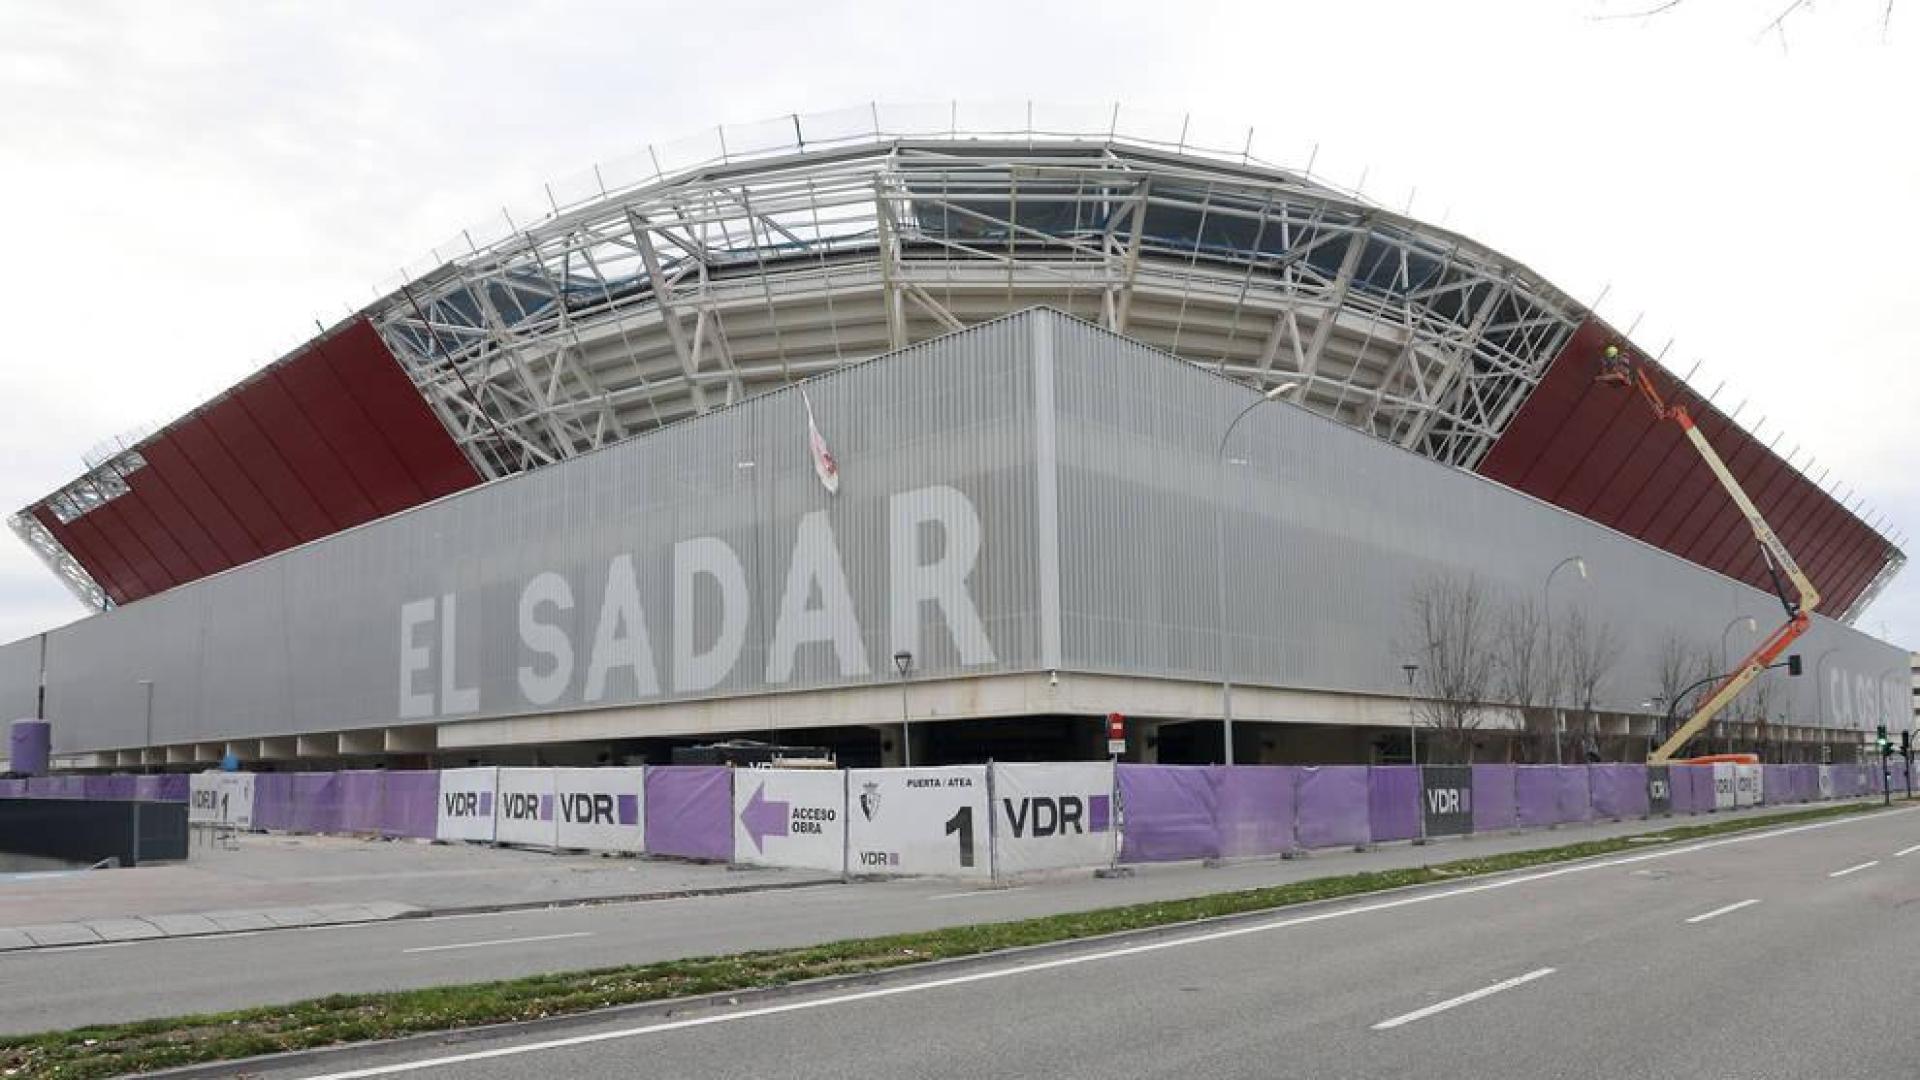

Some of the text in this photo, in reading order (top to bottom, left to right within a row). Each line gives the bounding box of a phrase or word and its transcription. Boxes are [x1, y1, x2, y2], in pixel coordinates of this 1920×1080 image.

[400, 485, 997, 718] EL SADAR
[906, 778, 941, 788] PUERTA
[948, 777, 972, 787] ATEA
[446, 791, 478, 816] VDR
[503, 792, 538, 820] VDR
[560, 793, 614, 824] VDR
[792, 807, 836, 821] ACCESO
[1427, 788, 1459, 814] VDR
[791, 821, 823, 834] OBRA
[1003, 796, 1083, 838] VDR
[945, 806, 974, 867] 1
[860, 852, 887, 865] VDR
